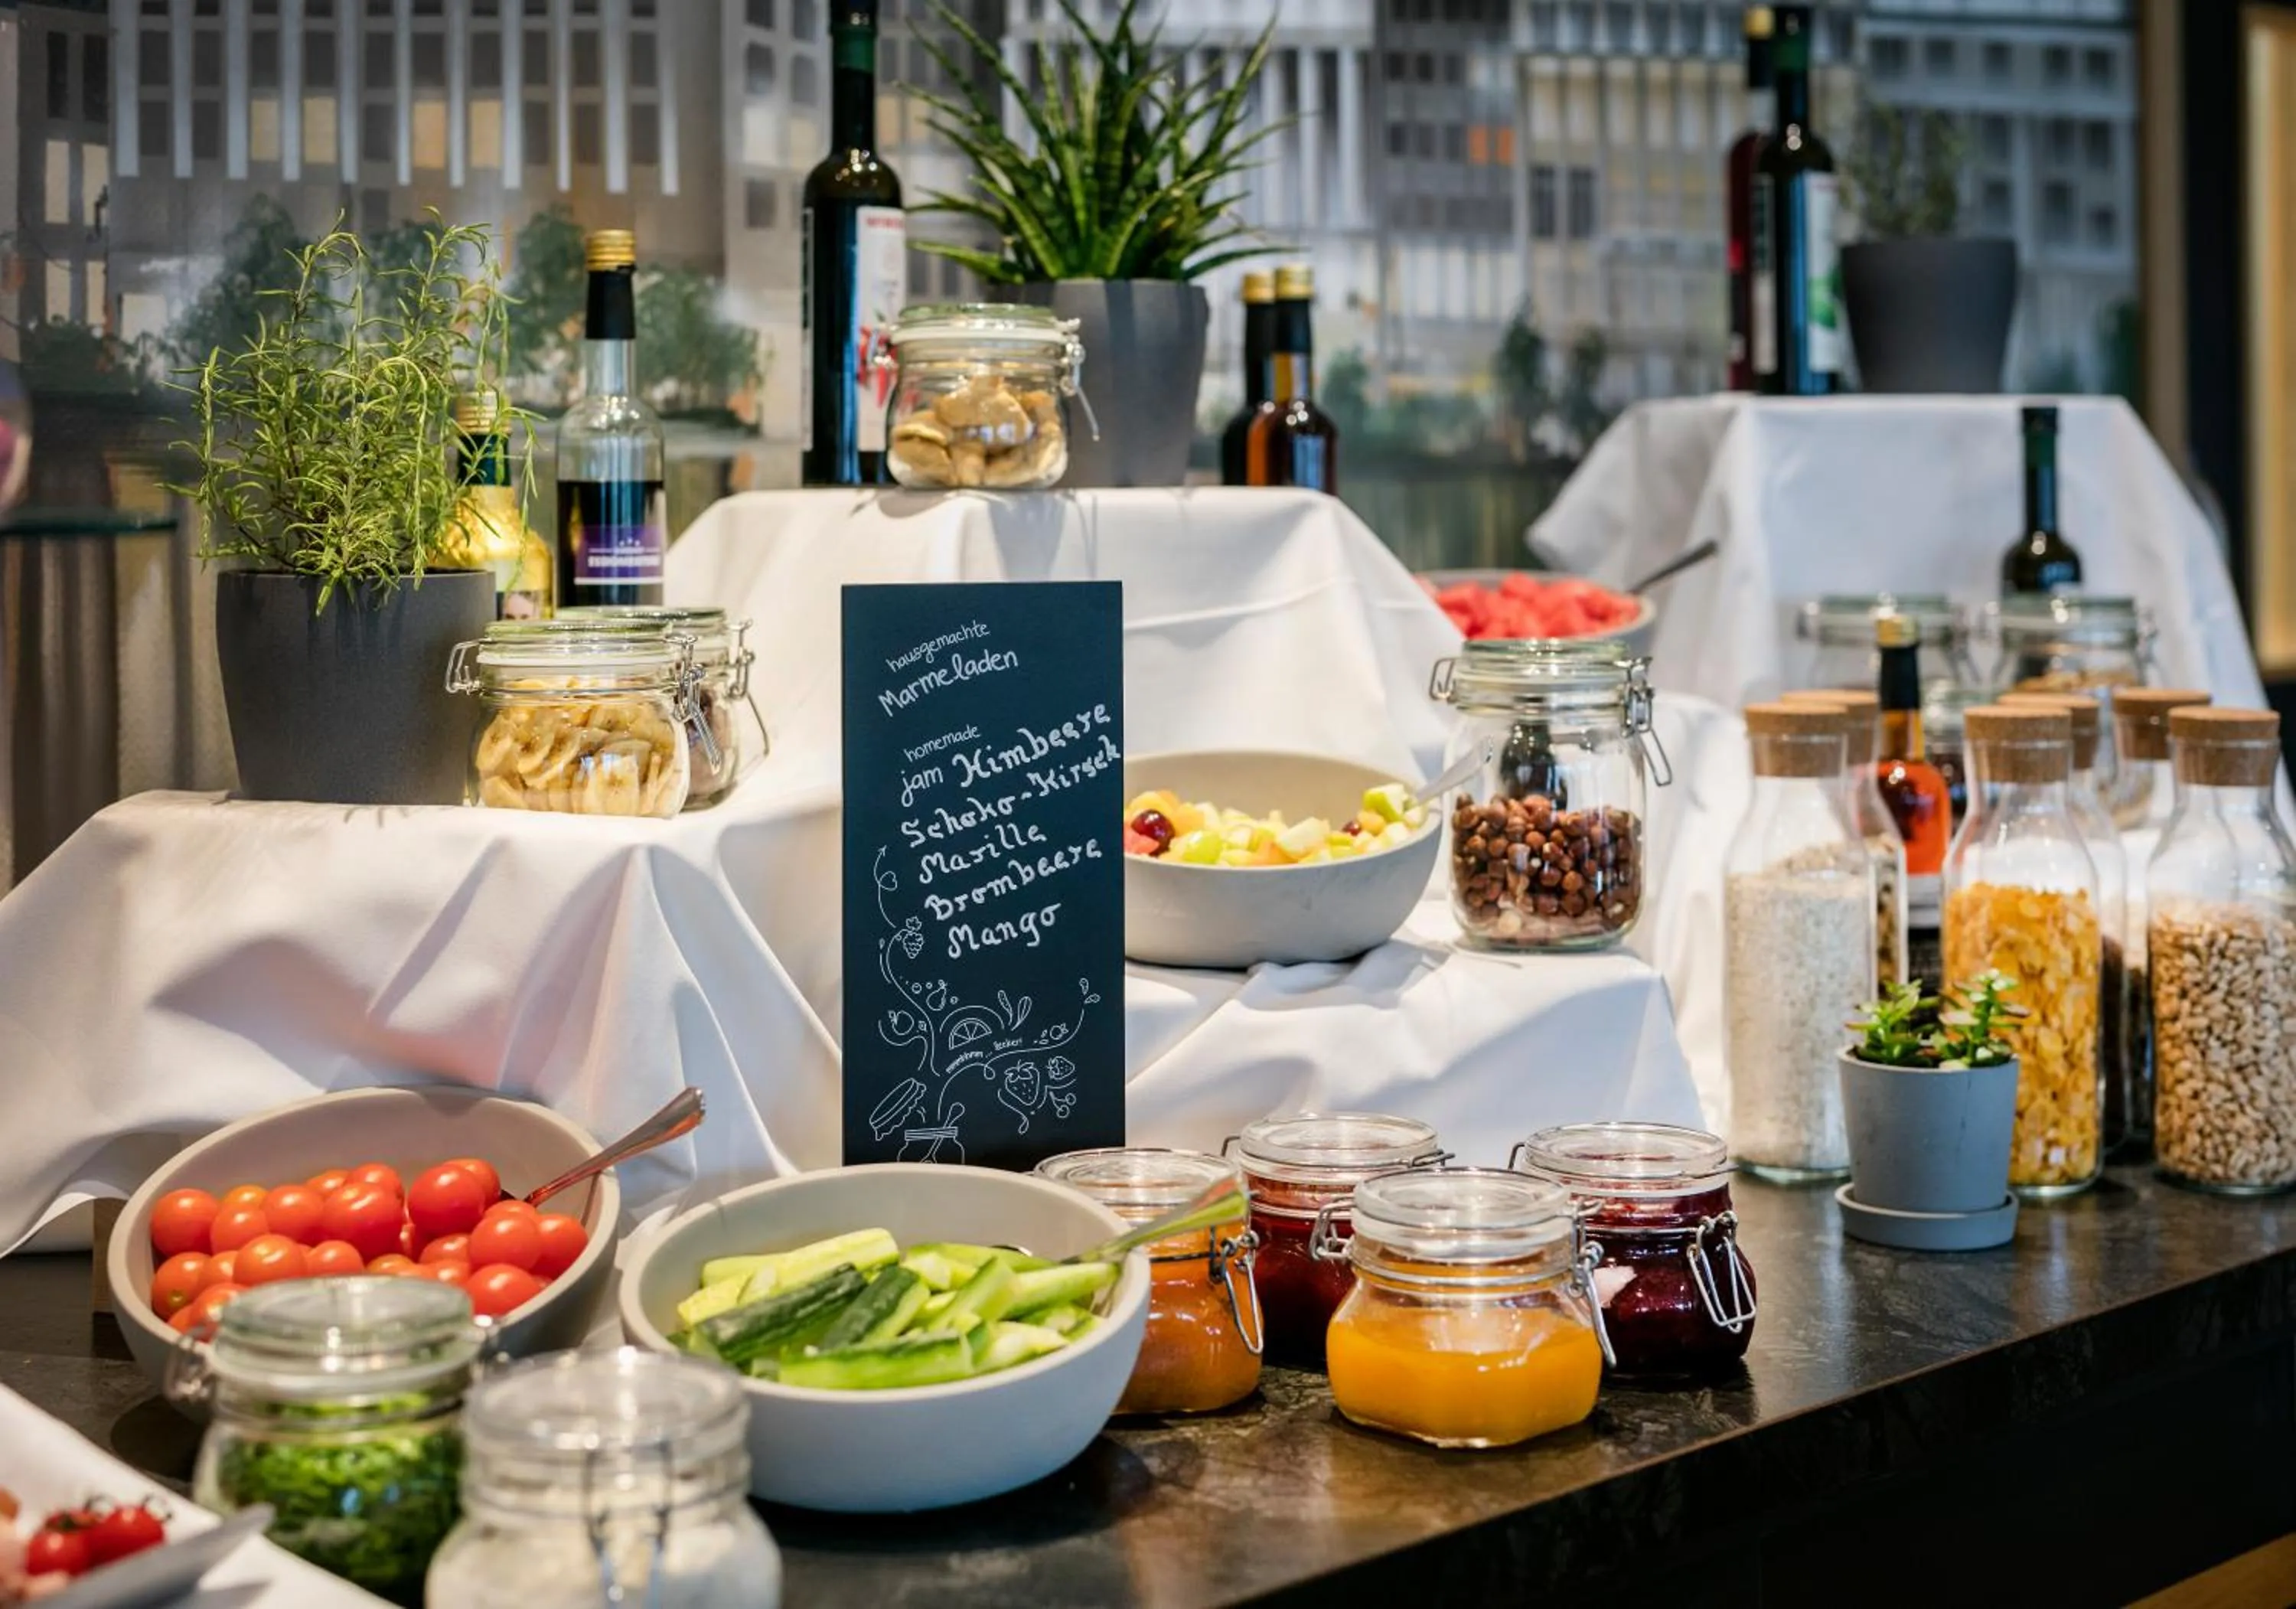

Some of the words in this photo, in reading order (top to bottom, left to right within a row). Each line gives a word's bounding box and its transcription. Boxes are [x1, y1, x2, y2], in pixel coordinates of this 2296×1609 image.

[886, 619, 990, 672] hausgemachte
[878, 649, 1019, 716] Marmeladen
[904, 724, 980, 762] homemade
[901, 767, 944, 808] jam
[919, 823, 1048, 884] Marille
[925, 838, 1102, 921] Brombeere
[948, 902, 1062, 959] Mango
